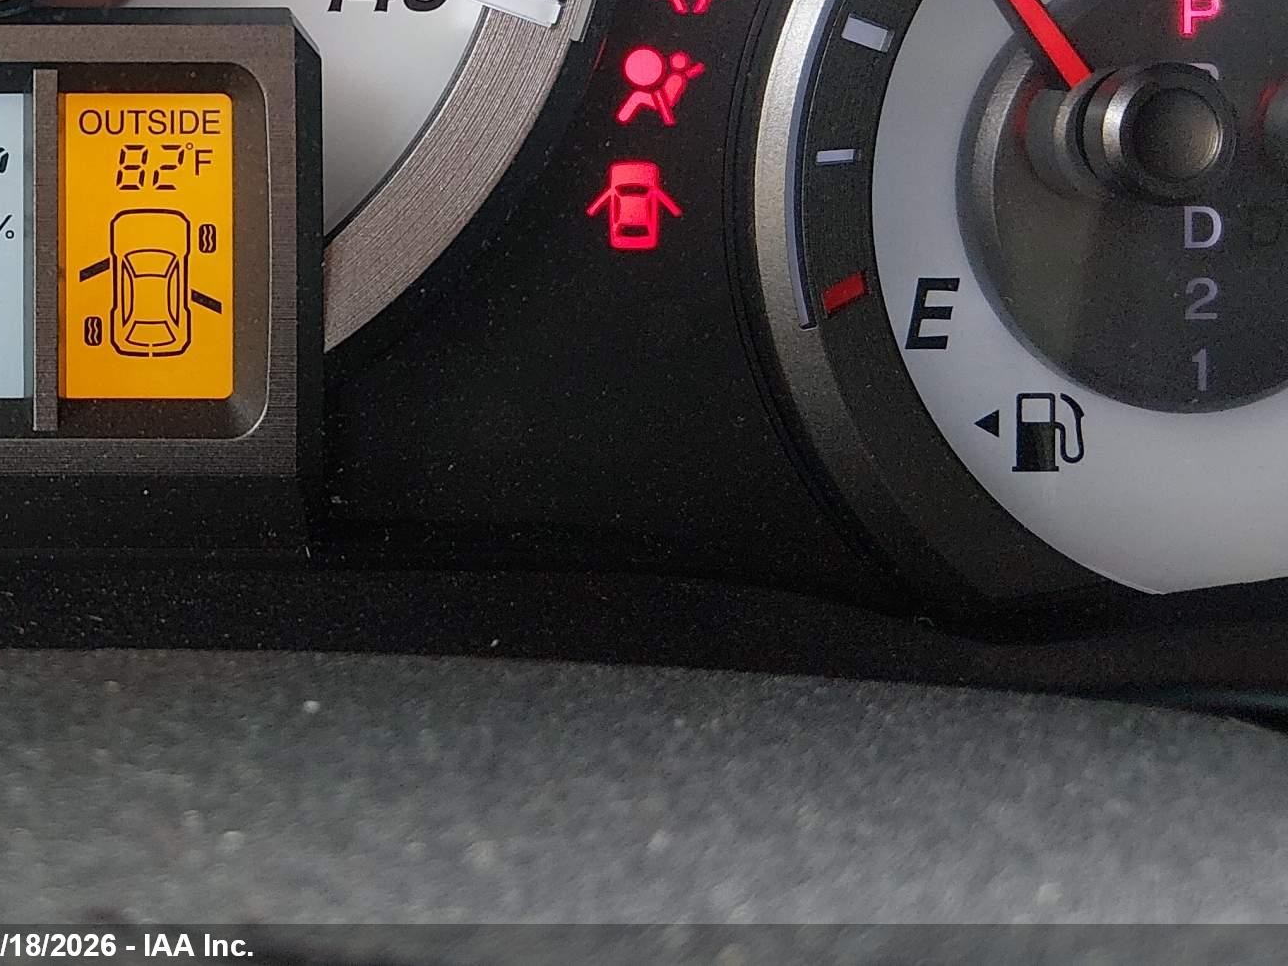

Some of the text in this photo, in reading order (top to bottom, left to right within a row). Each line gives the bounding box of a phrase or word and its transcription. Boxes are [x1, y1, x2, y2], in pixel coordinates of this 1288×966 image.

[79, 110, 220, 135] OUTSIDE
[1184, 206, 1222, 248] D
[905, 278, 960, 349] E
[1185, 278, 1218, 319] 2
[1192, 349, 1208, 391] 1
